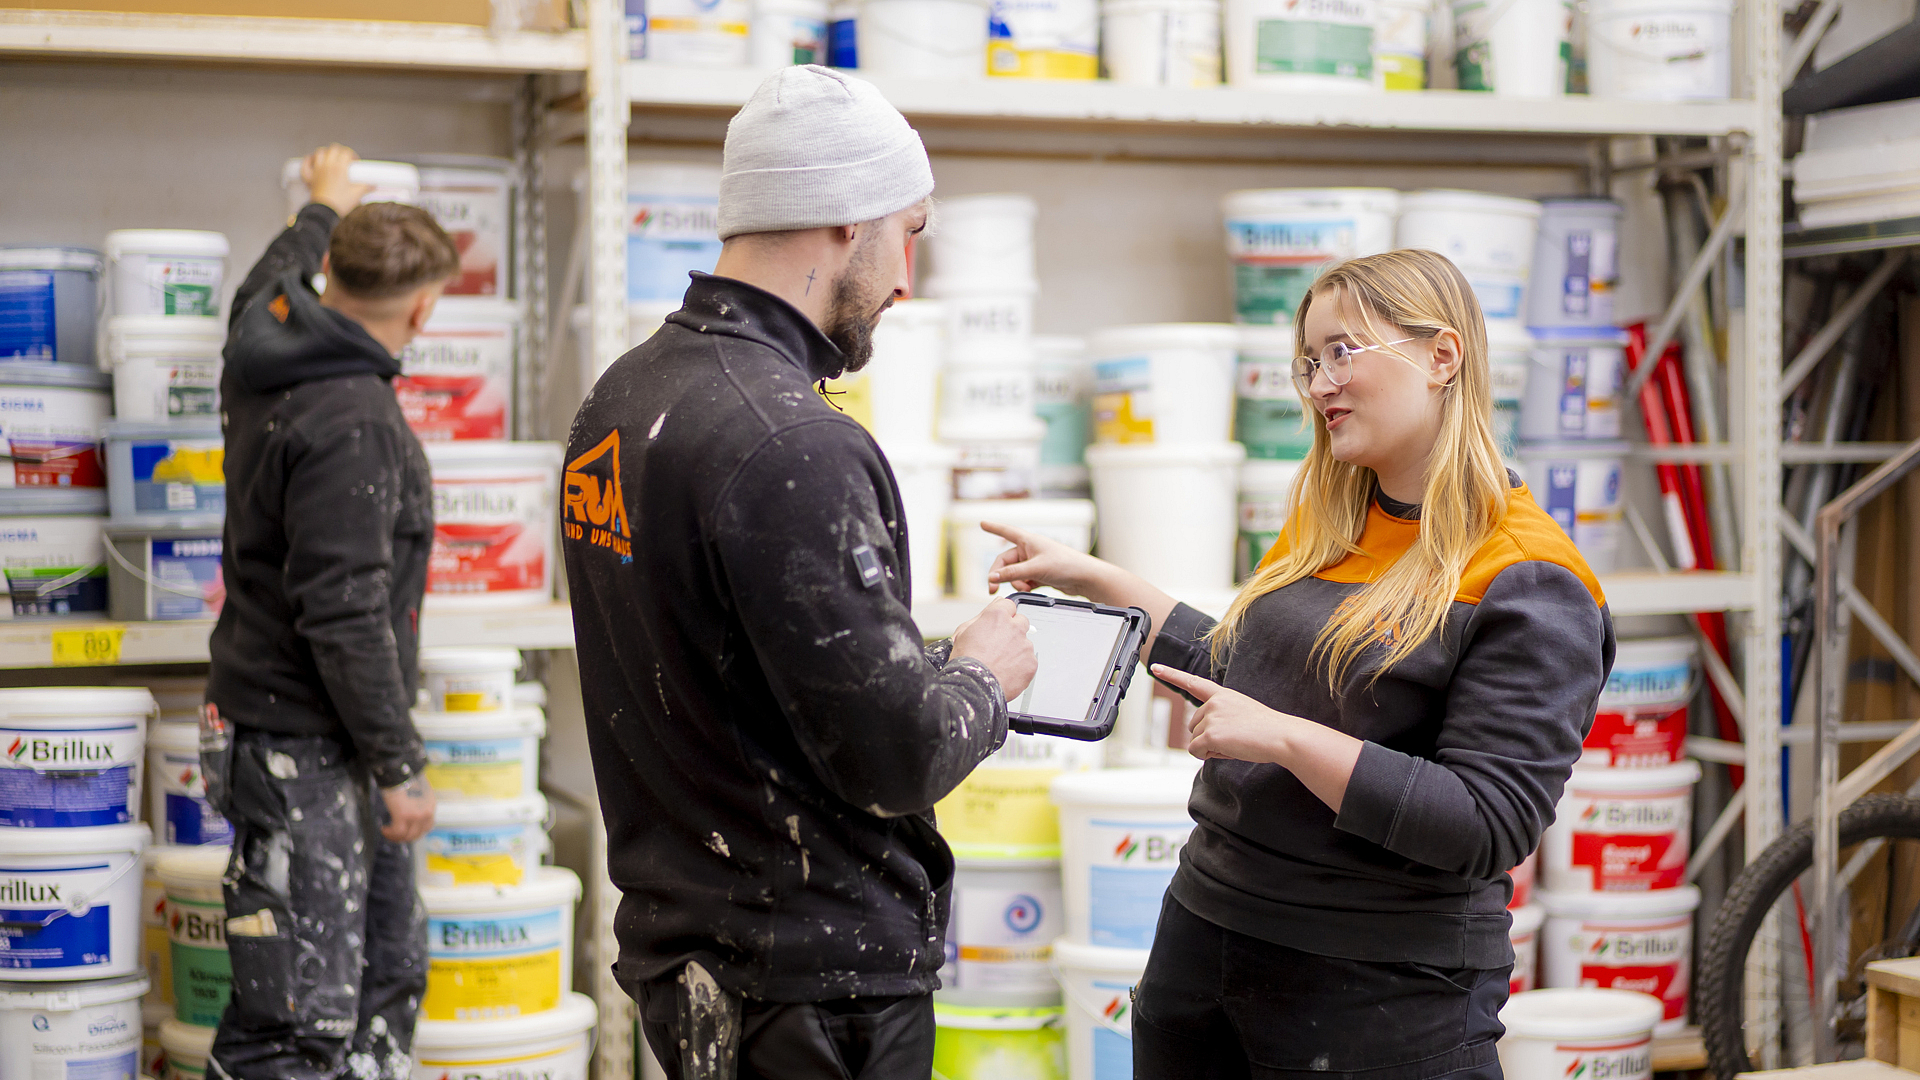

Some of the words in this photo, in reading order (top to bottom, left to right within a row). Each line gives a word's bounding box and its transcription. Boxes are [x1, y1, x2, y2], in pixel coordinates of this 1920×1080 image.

[1245, 225, 1320, 251] Brillux
[1, 397, 45, 413] SIGMA
[432, 489, 516, 515] Brillux
[0, 529, 39, 543] IGMA
[172, 539, 222, 556] FUNDA
[1608, 674, 1676, 693] Brillux
[32, 739, 114, 762] Brillux
[1605, 803, 1674, 826] Brillux
[0, 879, 62, 902] rillux
[441, 920, 530, 947] Brillux
[1616, 936, 1677, 958] Brillux
